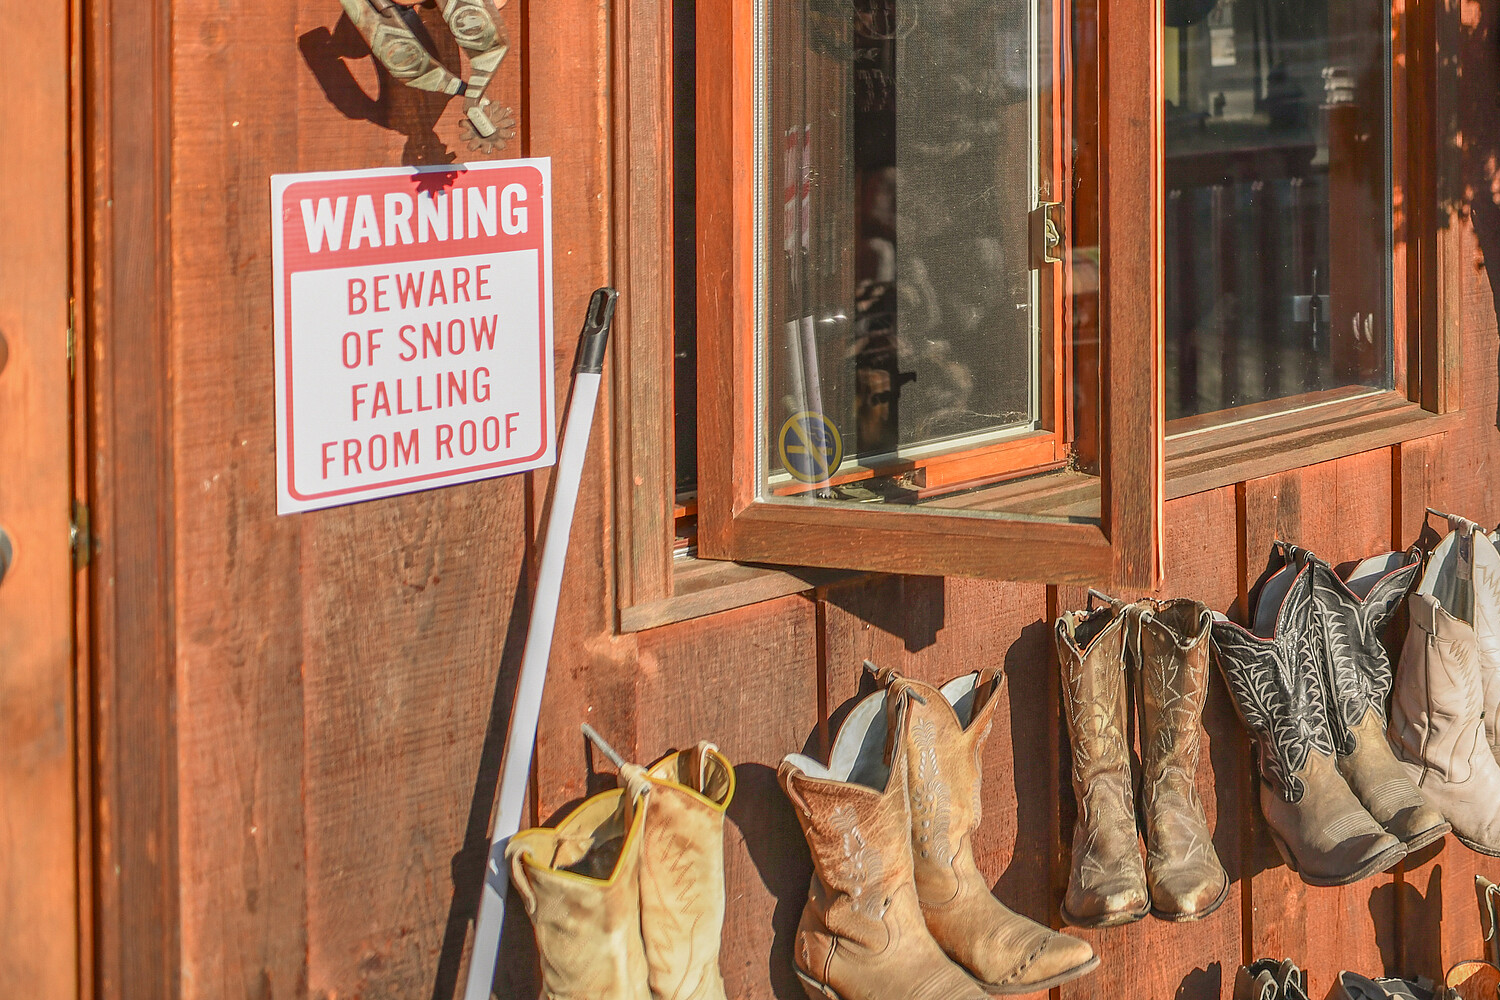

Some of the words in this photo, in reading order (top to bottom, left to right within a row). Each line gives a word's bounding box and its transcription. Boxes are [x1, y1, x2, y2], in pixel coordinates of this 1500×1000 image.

[300, 183, 528, 253] WARNING
[347, 264, 492, 316] BEWARE
[342, 328, 384, 369] OF
[398, 314, 498, 362] SNOW
[352, 366, 491, 421] FALLING
[321, 428, 420, 480] FROM
[436, 412, 520, 460] ROOF
